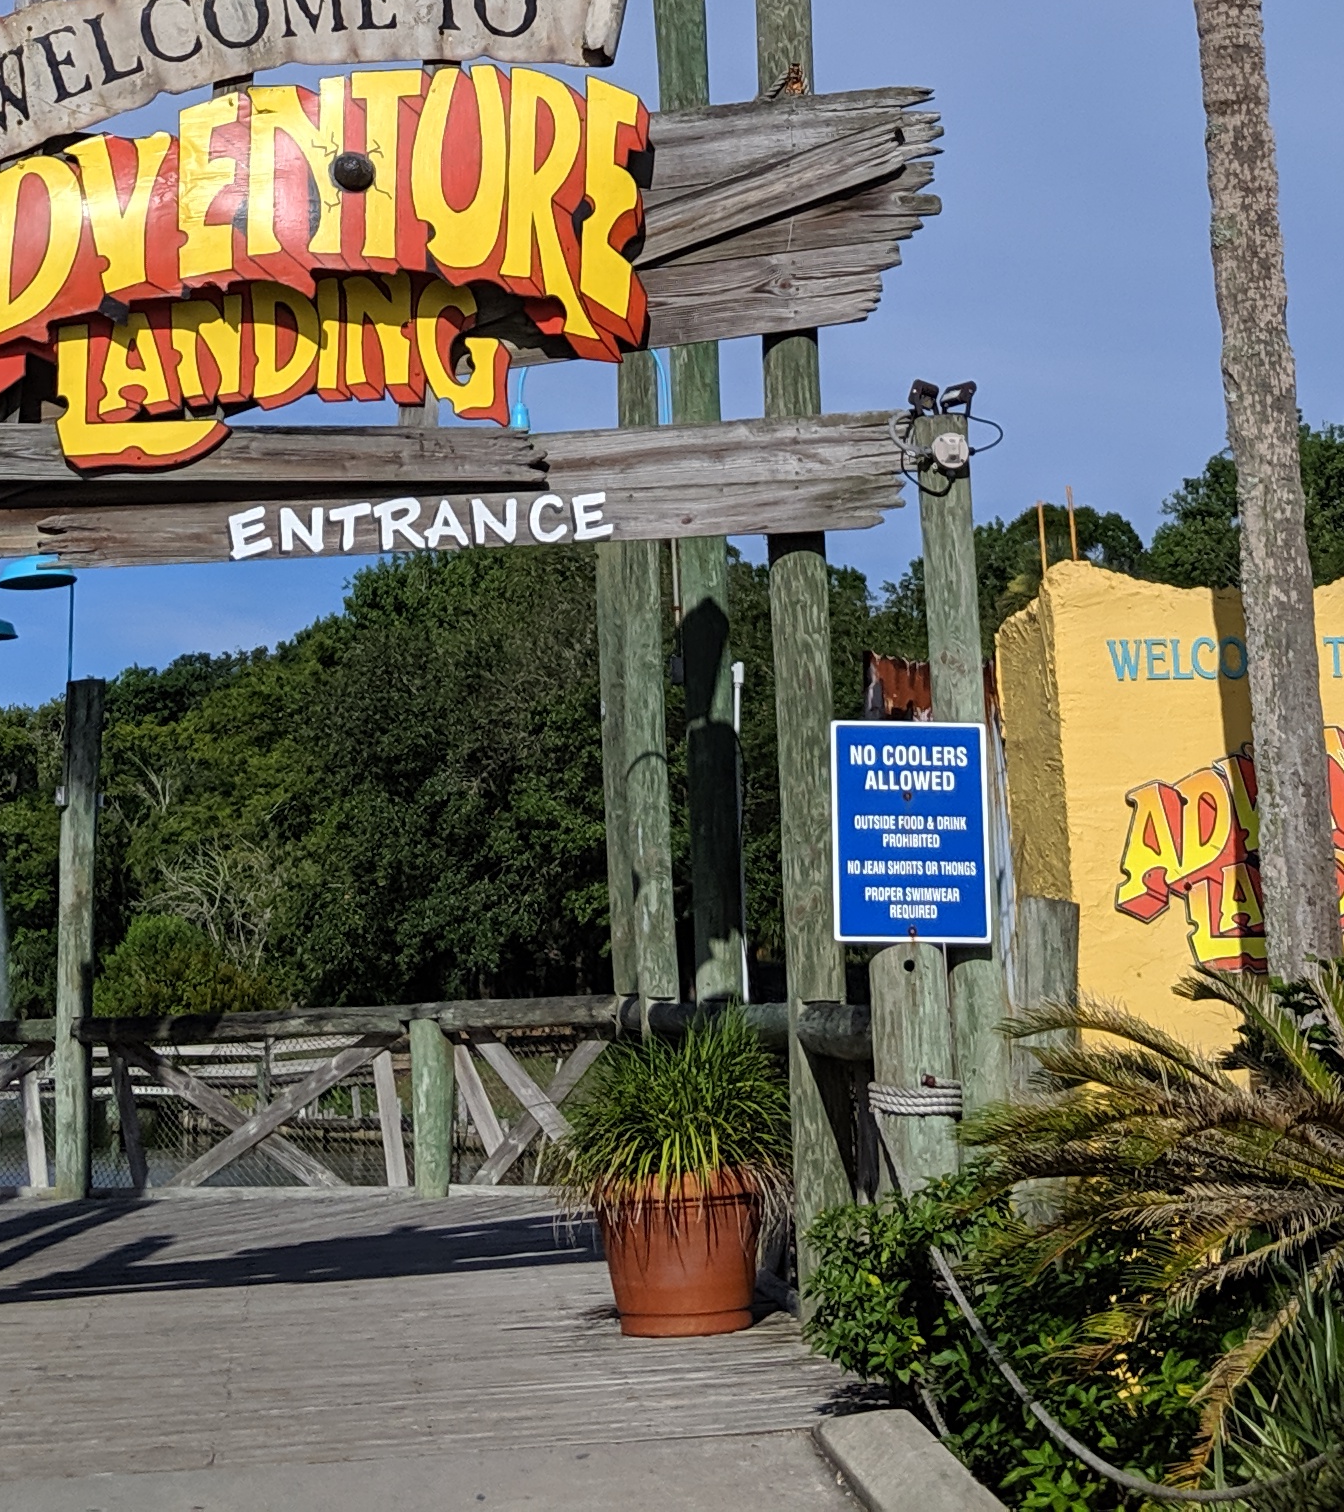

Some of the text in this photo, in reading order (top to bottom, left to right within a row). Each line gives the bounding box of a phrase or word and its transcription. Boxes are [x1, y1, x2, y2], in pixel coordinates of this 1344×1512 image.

[56, 273, 510, 472] LANDING
[228, 491, 614, 561] ENTRANCE
[1106, 635, 1249, 681] WELCO
[850, 745, 968, 767] NO COOLERS
[865, 770, 955, 791] ALLOWED
[854, 815, 967, 831] OUTSIDE FOOD & DRINK
[883, 834, 940, 848] PROHIBITED
[847, 860, 977, 876] NO JEAN SHORTS OR THONGS
[865, 887, 960, 903] PROPER SWIMWEAR
[890, 904, 937, 919] REQUIRED
